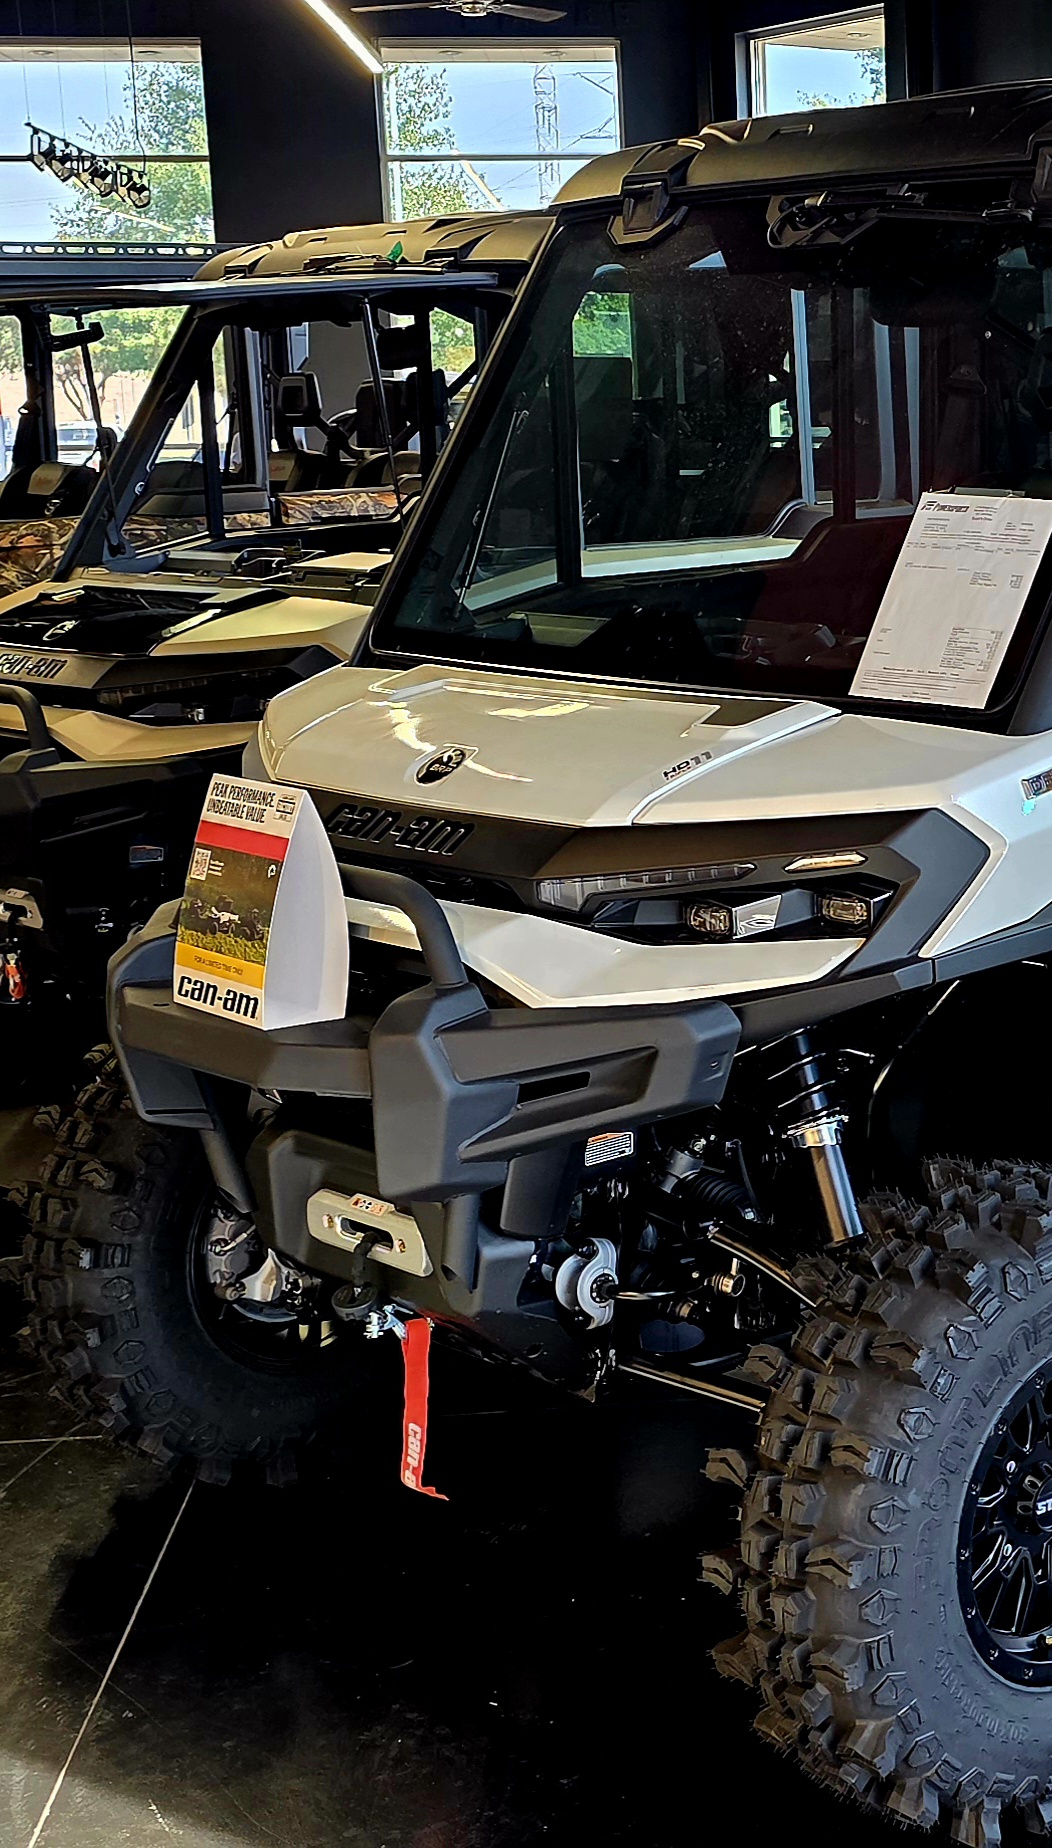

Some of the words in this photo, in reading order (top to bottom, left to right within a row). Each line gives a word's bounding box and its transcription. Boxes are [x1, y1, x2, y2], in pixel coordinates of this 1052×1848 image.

[429, 763, 454, 773] BRP
[206, 798, 246, 819] UNBEATABLE
[245, 805, 267, 823] VALUE
[210, 781, 230, 799] PEAK
[228, 785, 276, 808] PERFORMANCE
[325, 802, 476, 856] can-am
[177, 975, 259, 1019] can-am
[405, 1422, 422, 1489] can-a
